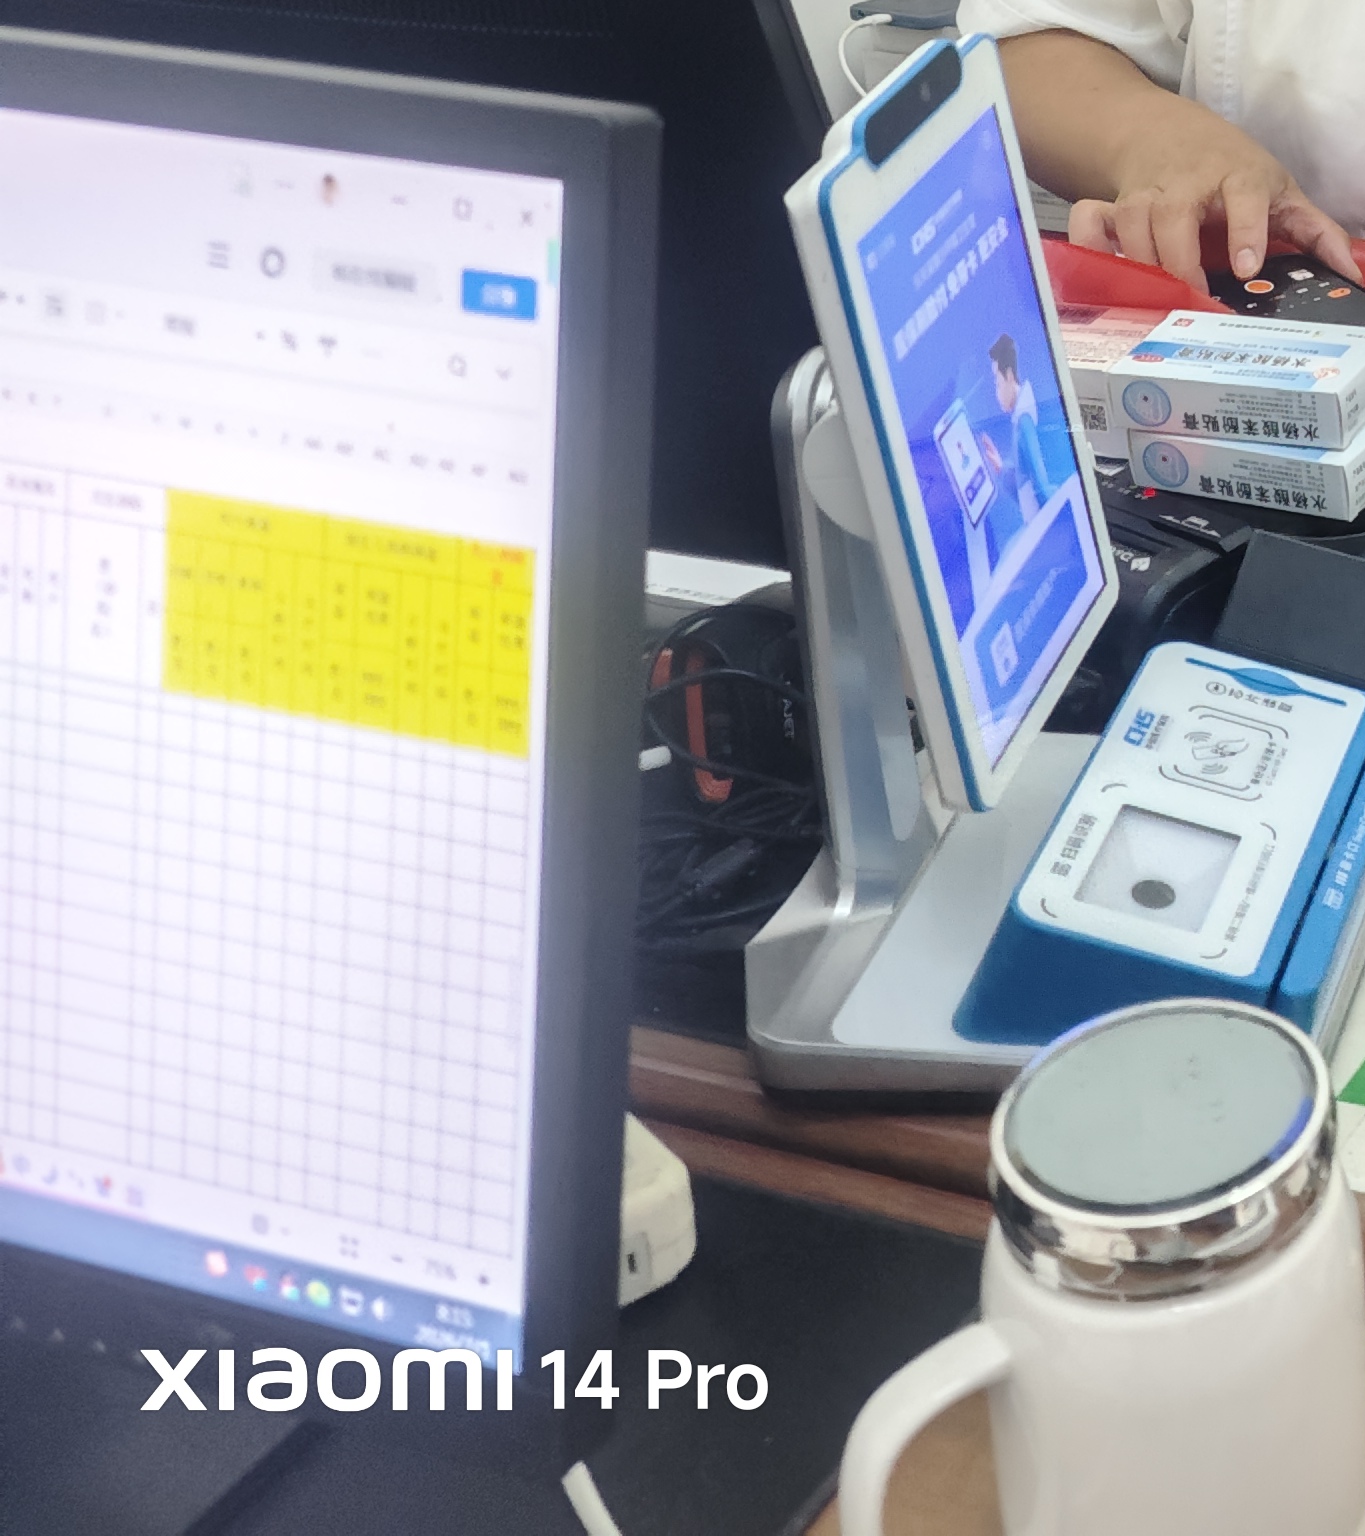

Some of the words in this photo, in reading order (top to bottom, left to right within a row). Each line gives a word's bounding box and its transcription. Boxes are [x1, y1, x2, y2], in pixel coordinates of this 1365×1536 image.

[1177, 346, 1312, 369] 水杨酸苯酚贴膏
[1182, 411, 1320, 441] 水杨酸苯酚贴膏
[1199, 474, 1328, 513] 水杨酸苯酚贴膏
